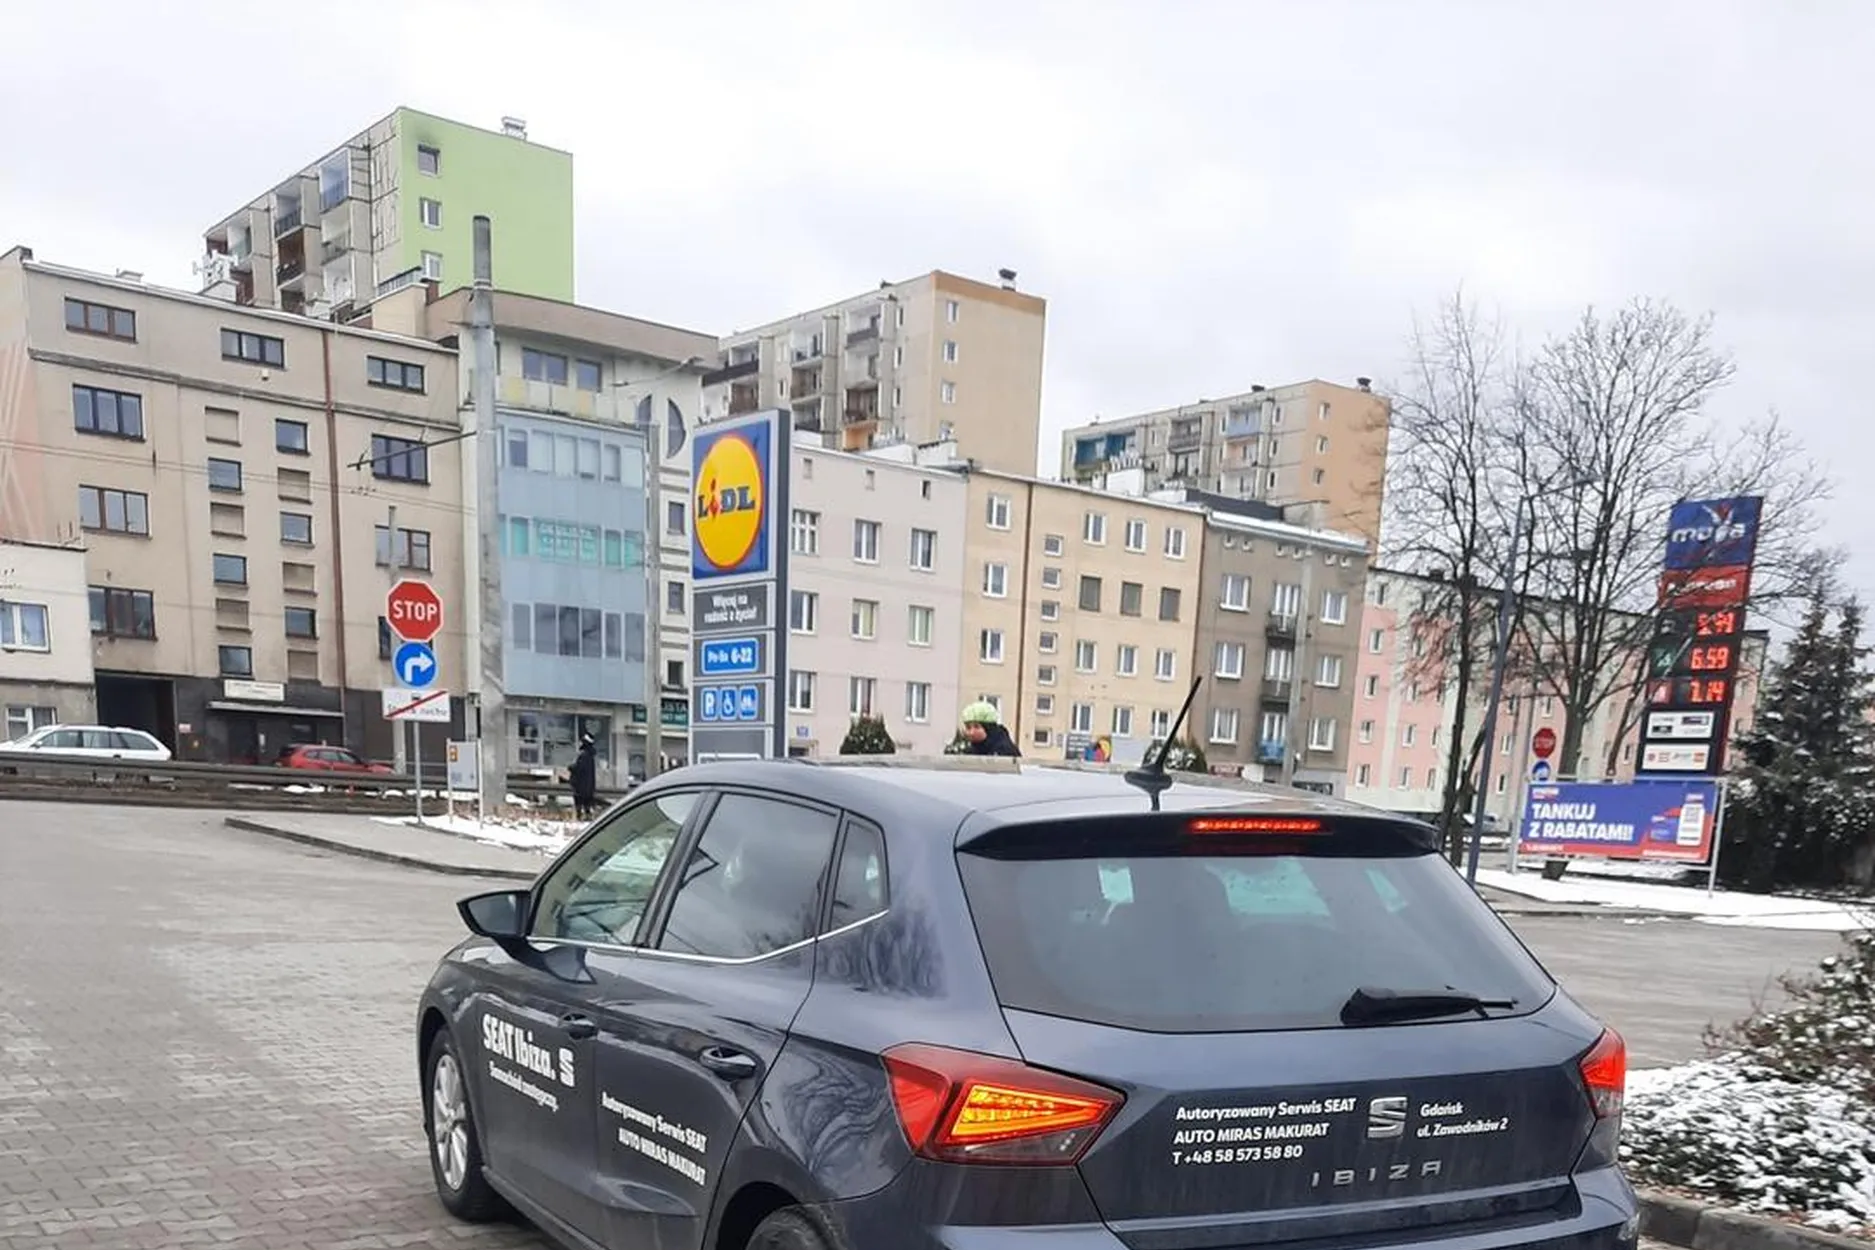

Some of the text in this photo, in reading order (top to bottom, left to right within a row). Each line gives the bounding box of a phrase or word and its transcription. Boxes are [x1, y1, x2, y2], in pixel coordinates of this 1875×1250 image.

[392, 600, 438, 621] STOP
[1532, 803, 1596, 820] TANKUJ
[1528, 821, 1540, 838] Z
[482, 1013, 514, 1060] SEAT
[1176, 1098, 1356, 1121] Autoryzowany Serwis SEAT
[1420, 1102, 1463, 1118] Gdańsk
[657, 1114, 686, 1143] Serwis
[686, 1127, 707, 1153] SEAT
[1173, 1122, 1330, 1145] AUTO MIRAS MAKURAT
[1433, 1119, 1499, 1137] Zawodników
[1500, 1117, 1508, 1130] 2
[619, 1127, 640, 1151] AUTO
[1172, 1144, 1303, 1165] T +48 58 573 58 80
[1311, 1160, 1442, 1188] IBIZA
